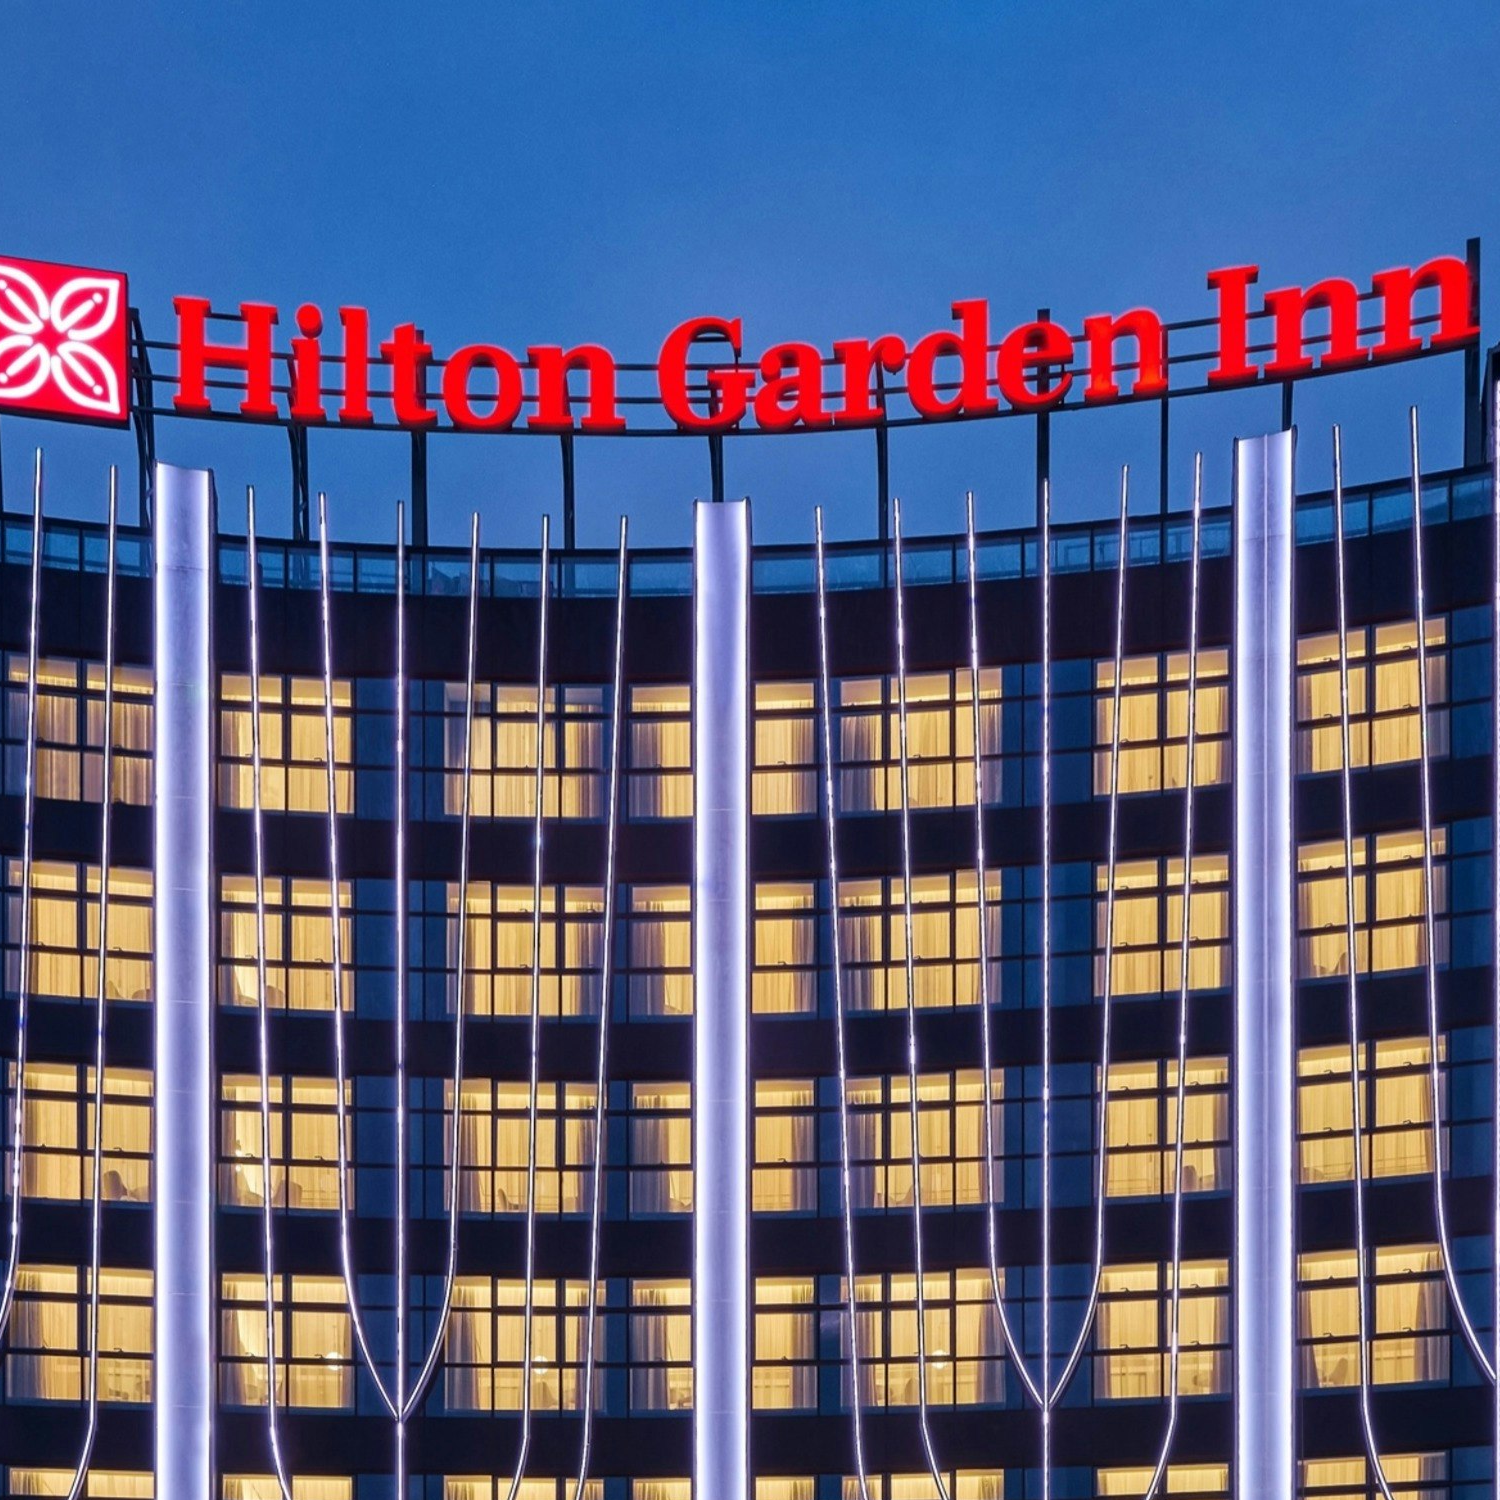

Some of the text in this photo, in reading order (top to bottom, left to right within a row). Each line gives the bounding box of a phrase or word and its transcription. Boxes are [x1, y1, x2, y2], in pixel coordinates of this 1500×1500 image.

[172, 256, 1481, 431] Hilton Garden Inn
